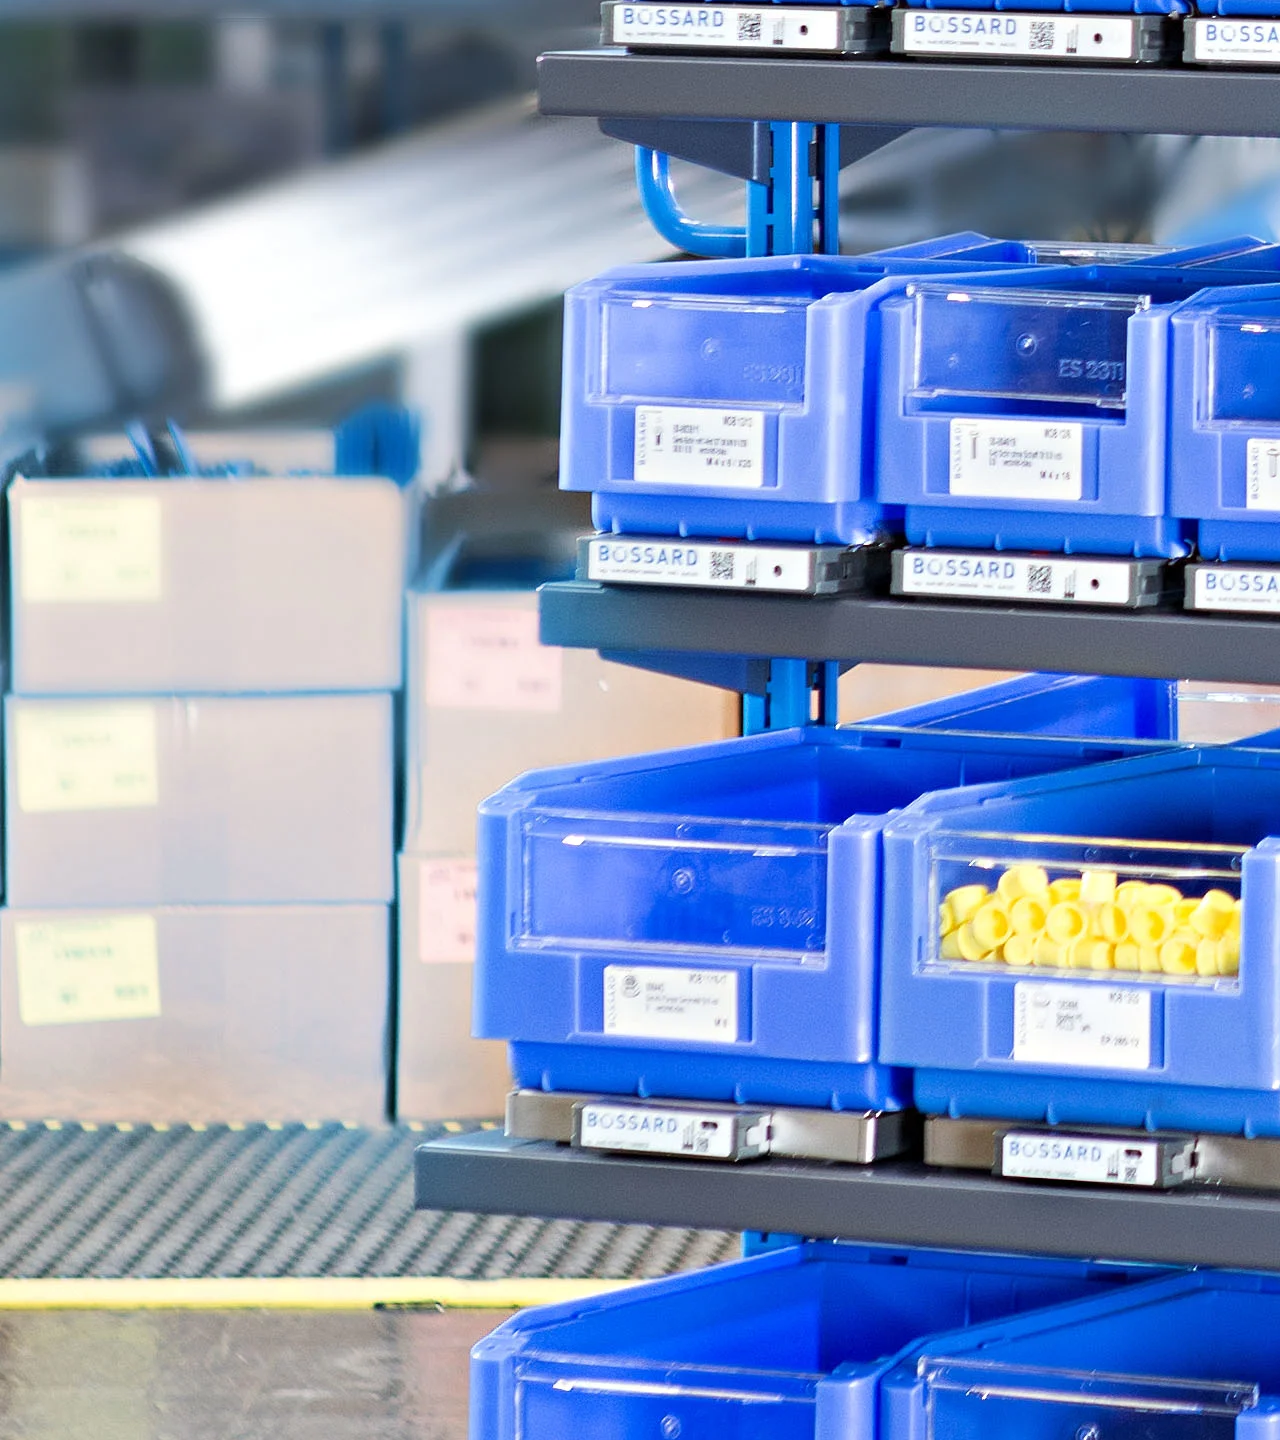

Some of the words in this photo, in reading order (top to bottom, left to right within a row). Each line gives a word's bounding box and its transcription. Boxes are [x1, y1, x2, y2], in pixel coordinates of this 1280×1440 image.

[624, 6, 726, 27] BOSSARD
[915, 14, 1018, 35] BOSSARD
[599, 543, 699, 566] BOSSARD
[913, 556, 1017, 579] BOSSARD
[587, 1111, 679, 1133] BOSSARD
[1009, 1139, 1103, 1161] BOSSARD
